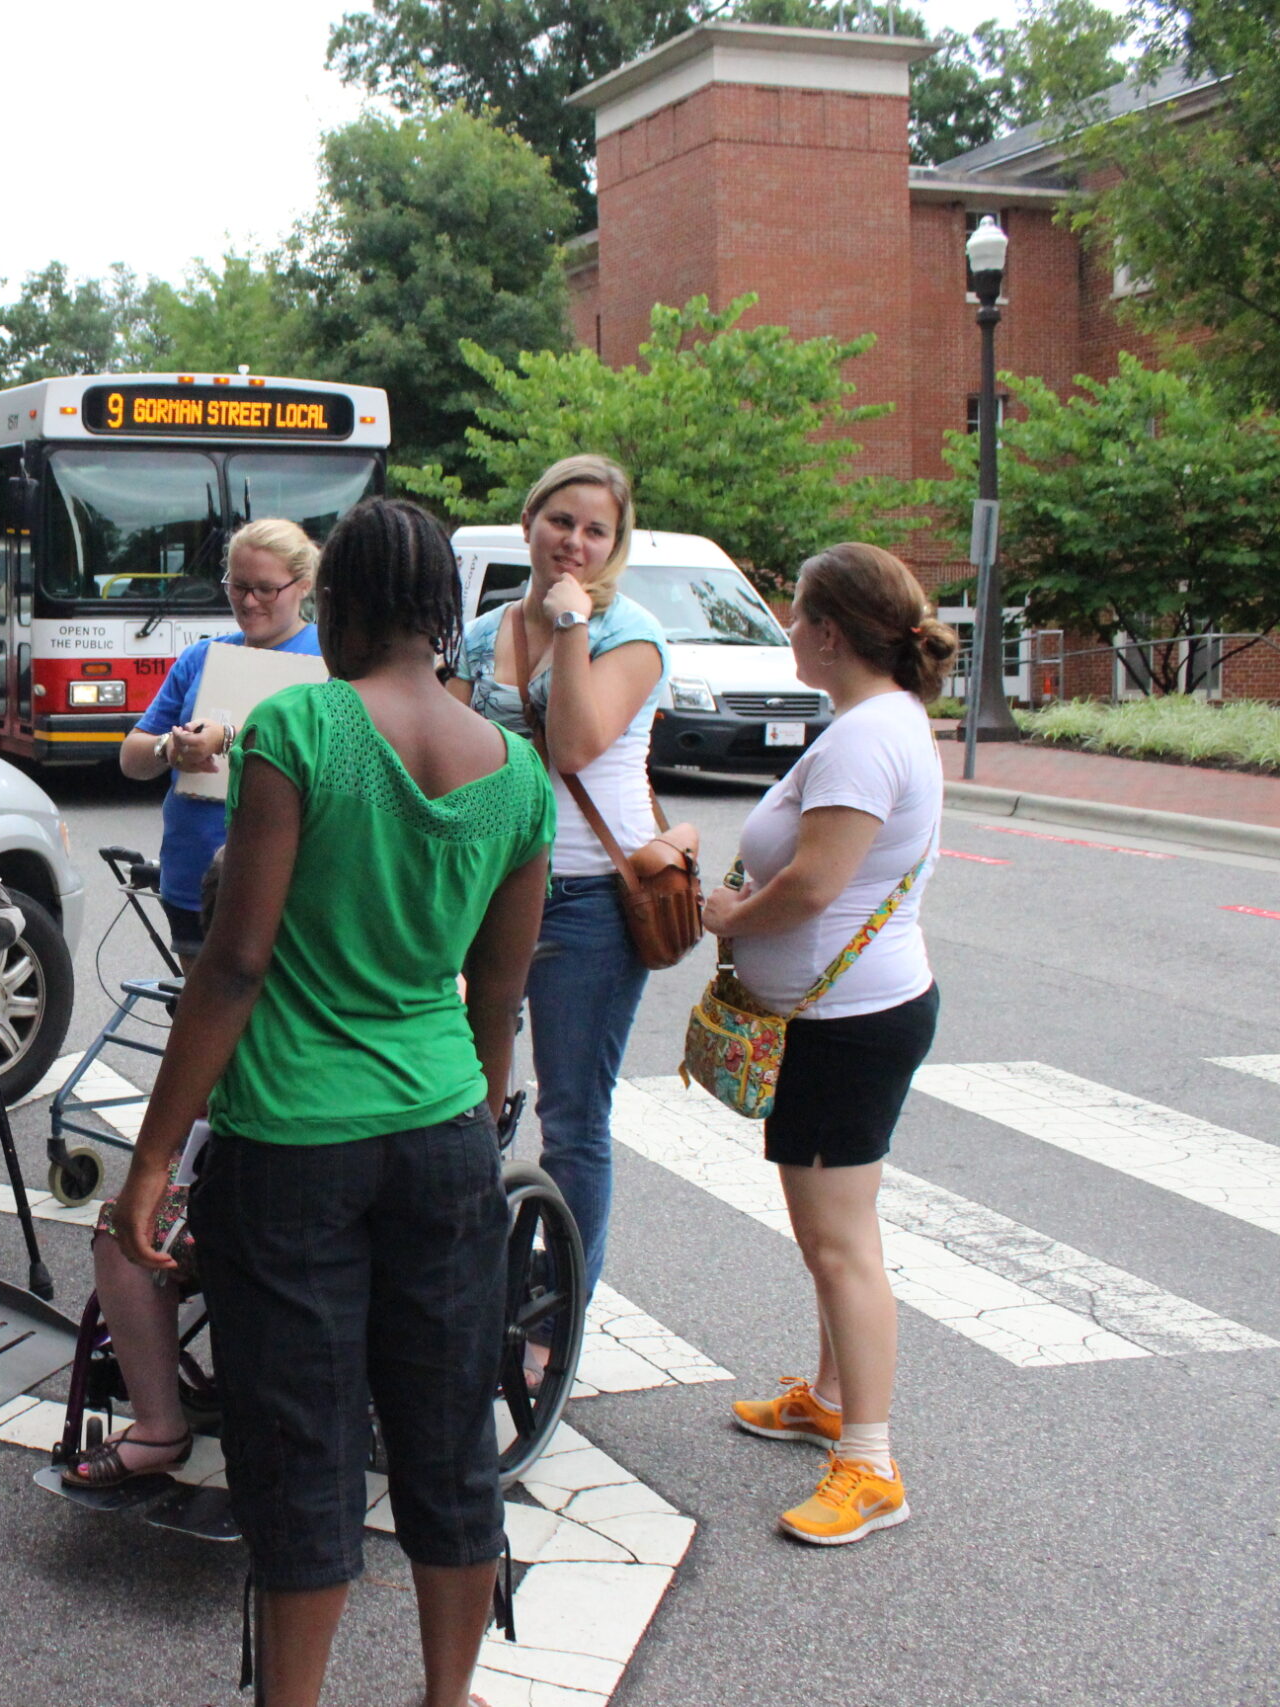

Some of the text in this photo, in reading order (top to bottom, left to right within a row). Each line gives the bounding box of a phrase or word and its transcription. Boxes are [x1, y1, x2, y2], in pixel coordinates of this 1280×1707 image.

[107, 393, 328, 429] 9 GORMAN STREET LOCAL
[59, 625, 106, 636] OPEN TO
[50, 639, 114, 650] THE PUBLIC
[133, 659, 166, 675] 1511
